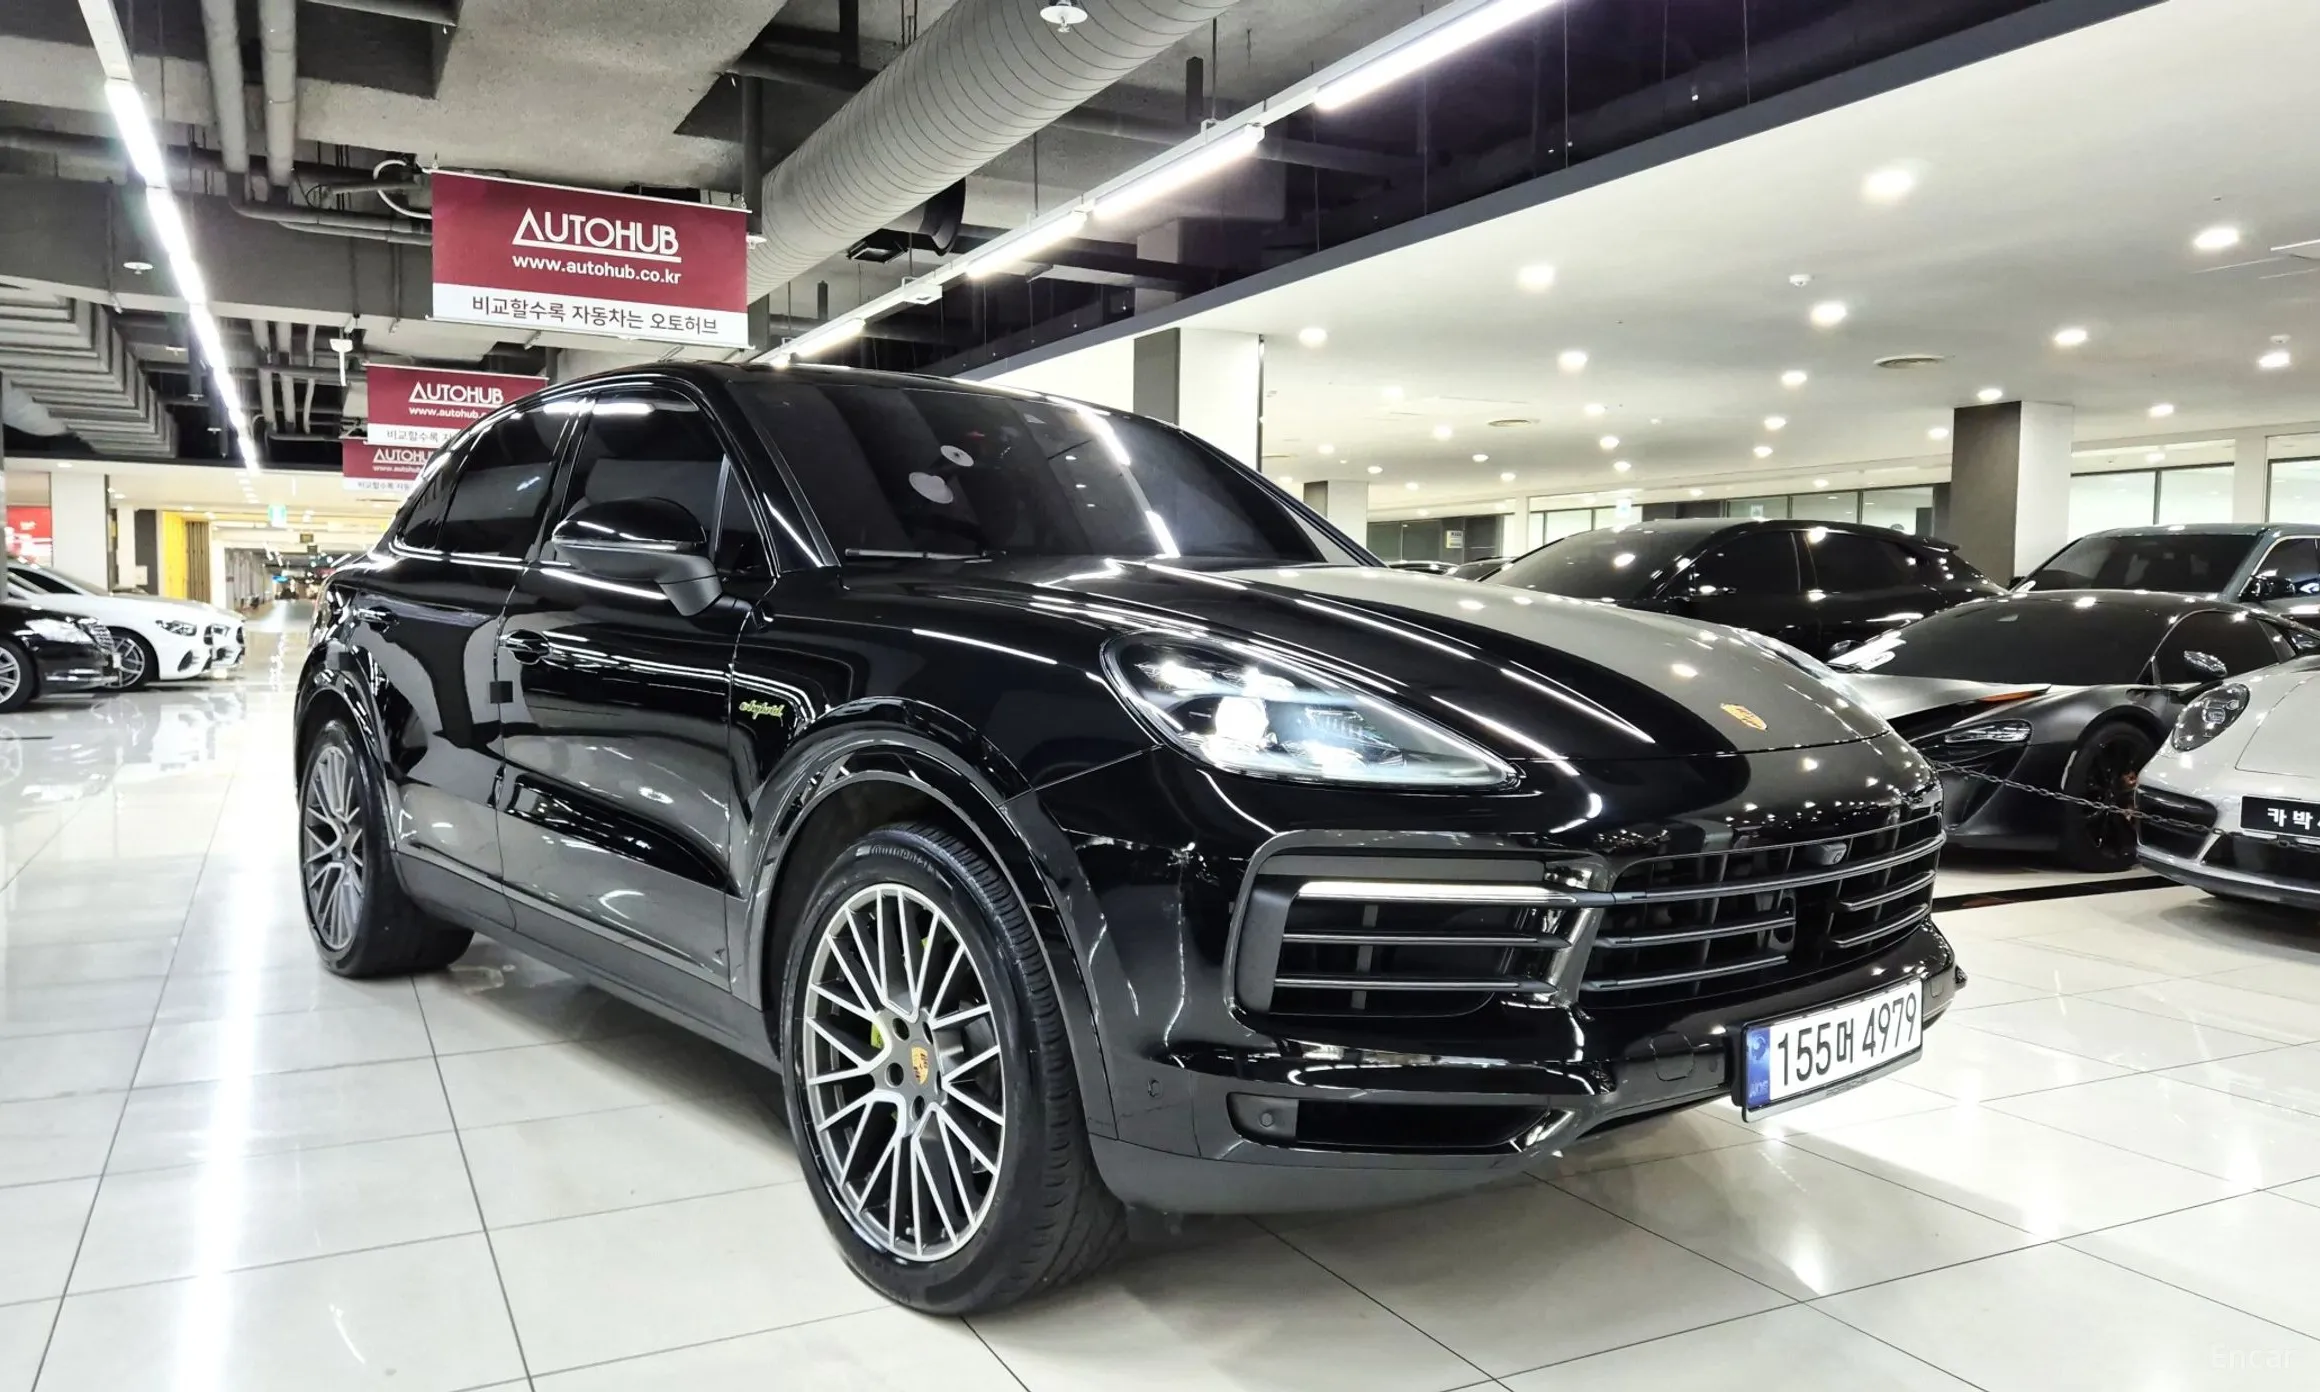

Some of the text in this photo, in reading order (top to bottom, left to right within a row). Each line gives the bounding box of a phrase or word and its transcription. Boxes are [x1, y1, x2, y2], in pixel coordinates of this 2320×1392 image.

[512, 208, 680, 258] AUTOHUB
[512, 255, 681, 285] www.autohub.co.kr
[472, 295, 719, 335] 비교할수록 자동차는 오토허브
[409, 381, 504, 405] AUTOHUB
[373, 448, 433, 464] AUTOHU
[1778, 993, 1917, 1087] 155머 4979
